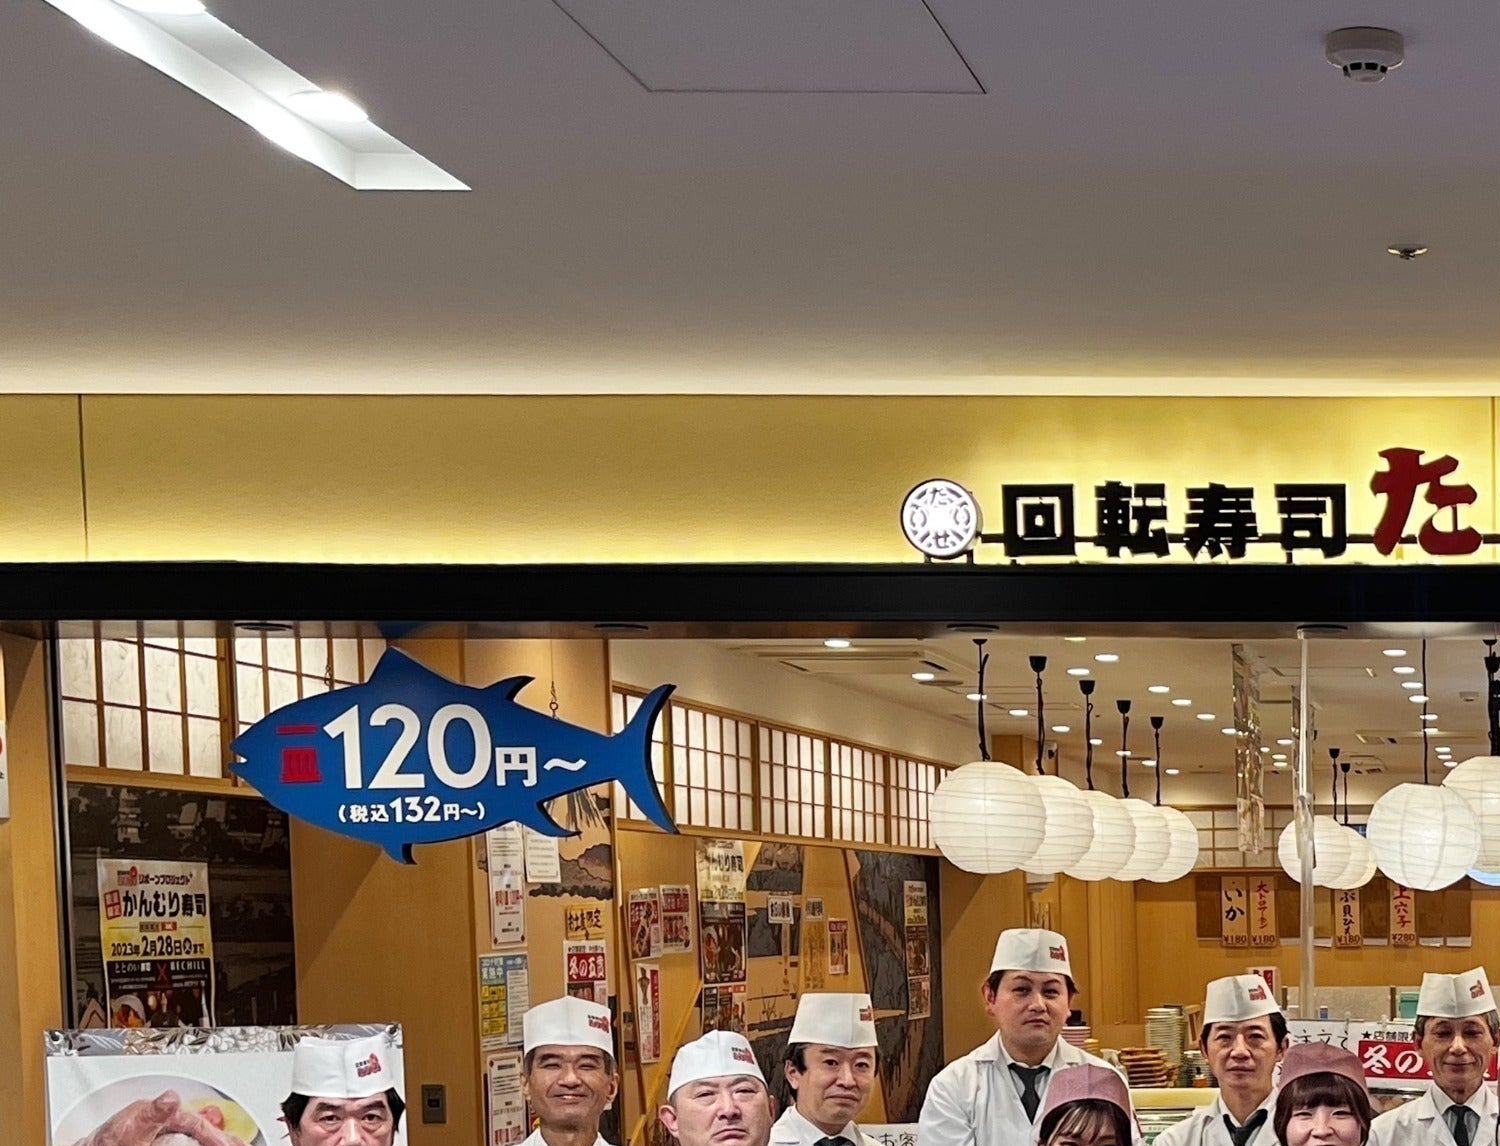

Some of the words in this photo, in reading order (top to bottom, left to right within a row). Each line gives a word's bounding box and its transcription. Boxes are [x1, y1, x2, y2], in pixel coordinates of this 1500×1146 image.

[1002, 481, 1346, 560] 回転寿司
[123, 890, 206, 917] かんむり寿司
[1224, 888, 1245, 922] いか
[1223, 934, 1247, 944] ¥180
[1391, 933, 1416, 942] ¥280
[1373, 1031, 1414, 1042] 店舗限
